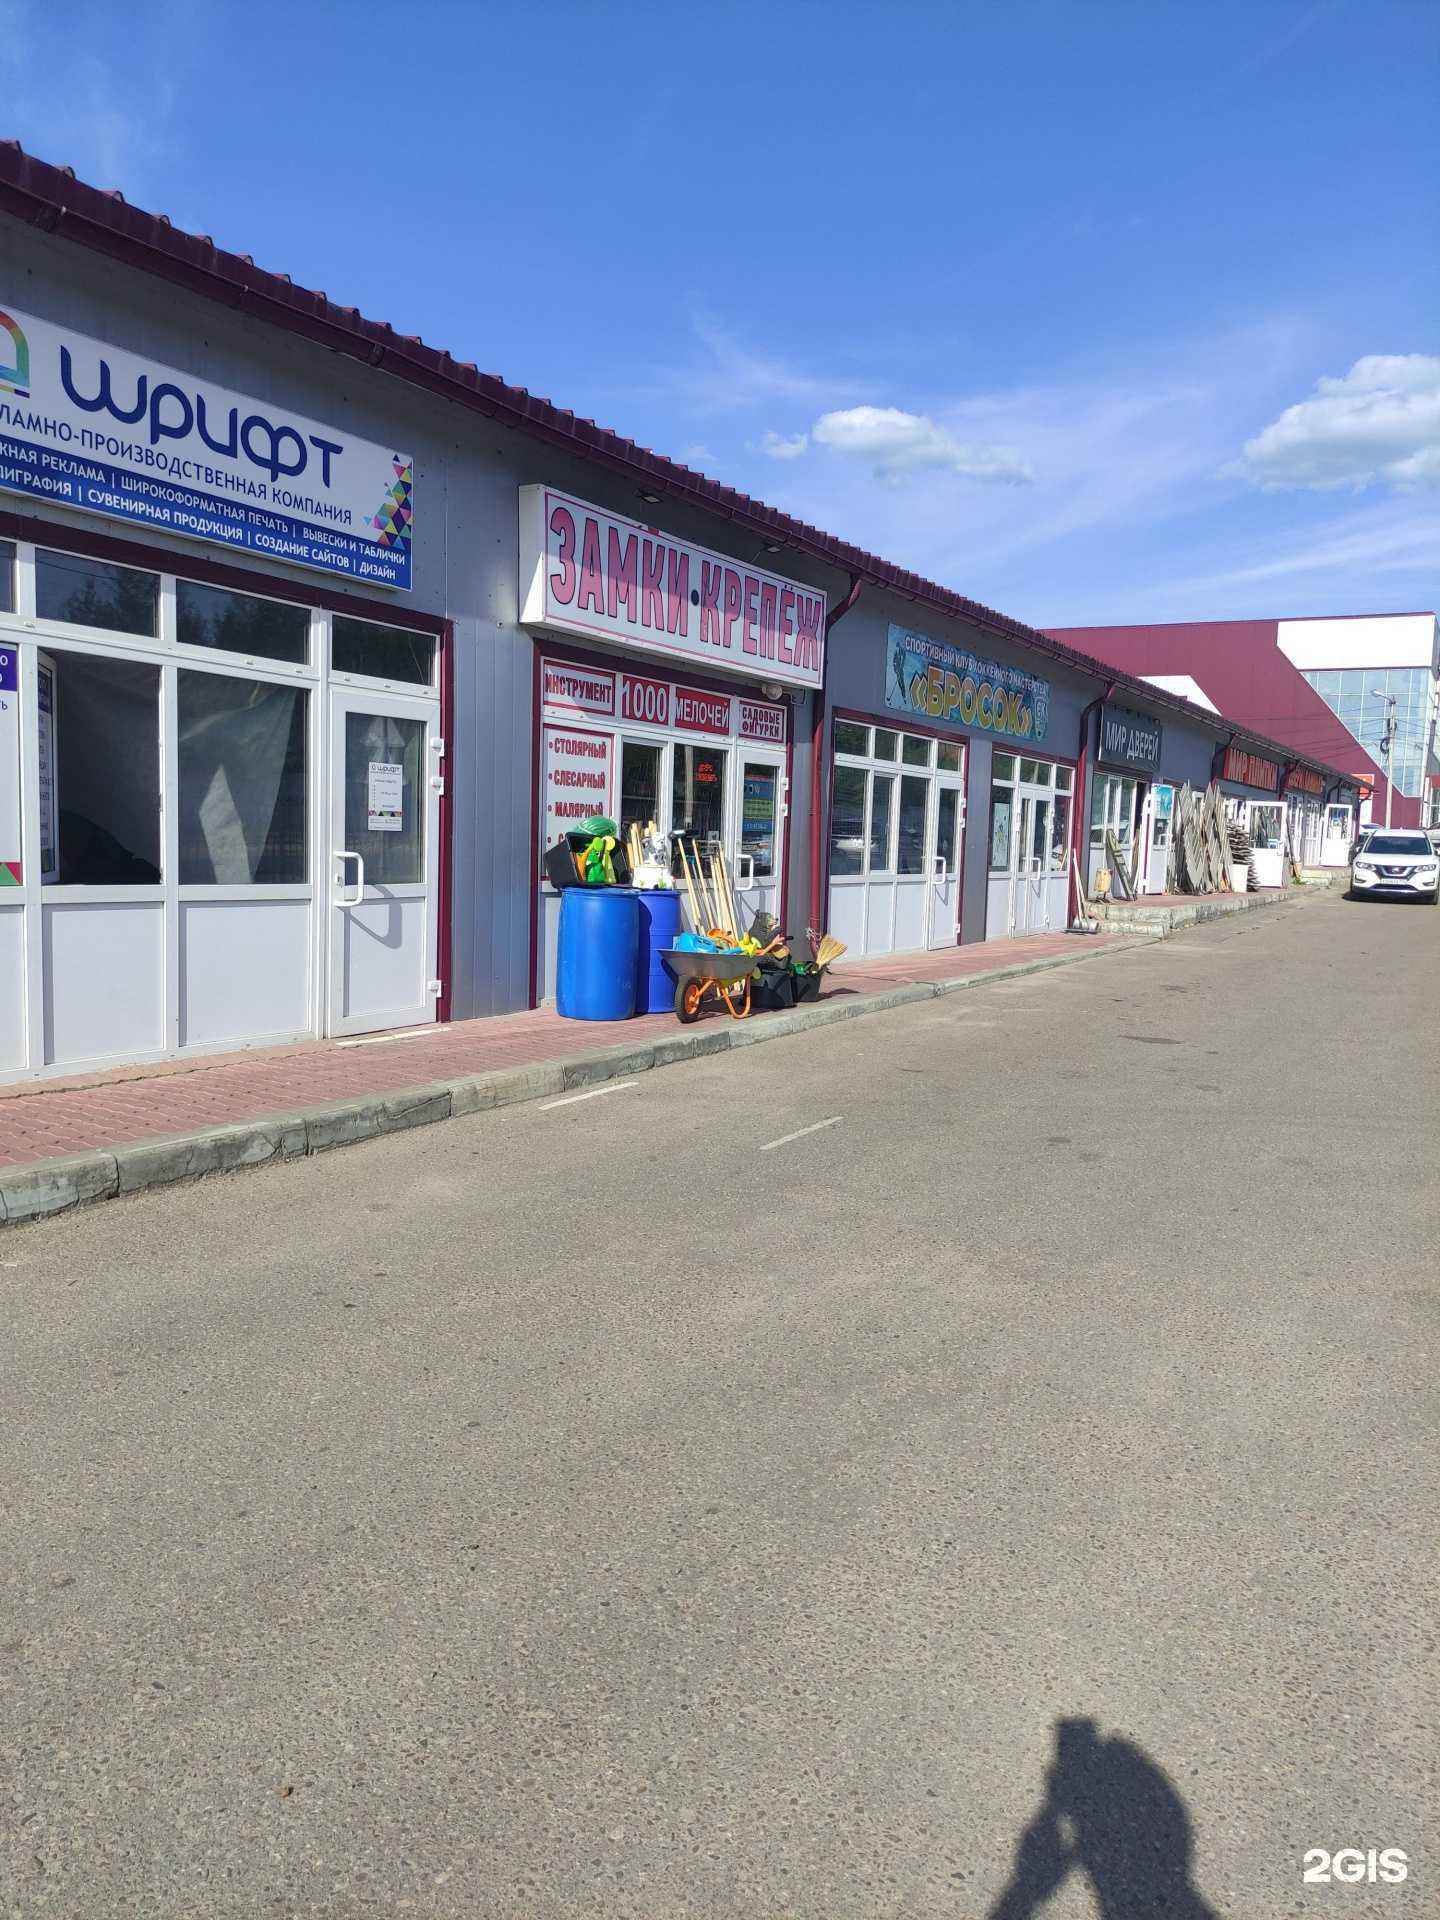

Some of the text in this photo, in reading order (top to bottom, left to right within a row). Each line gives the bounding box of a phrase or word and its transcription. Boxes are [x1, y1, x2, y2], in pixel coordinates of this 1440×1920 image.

[42, 453, 106, 484] РЕКЛАМА
[121, 476, 246, 522] ШИРОКОФОРМАТНАЯ
[248, 511, 289, 534] ПЕЧАТЬ
[303, 527, 347, 550] ВЫВЕСКИ
[350, 539, 357, 552] И
[358, 543, 406, 566] ТАБЛИЧКИ
[272, 487, 352, 526] КОМПАНИЯ
[88, 489, 171, 522] СУВЕНИРНАЯ
[173, 510, 243, 541] ПРОДУКЦИЯ
[255, 533, 309, 558] СОЗДАНИЕ
[311, 548, 350, 568] САЙТОВ
[359, 561, 396, 580] ДИЗАЙН
[549, 507, 690, 638] ЗАМКИ
[905, 635, 956, 665] СПОРТИВНЫЙ
[544, 672, 612, 704] ИНСТРУМЕНТ
[622, 680, 729, 728] 1000 МЕЛОЧЕЙ
[742, 706, 780, 725] САДОВЫЕ
[742, 721, 780, 737] ФИГУРКИ
[554, 737, 607, 761] СТОЛЯРНЫЙ
[1105, 721, 1159, 762] МИР ДВЕРЕЙ
[554, 770, 606, 790] СЛЕСАРНЫЙ
[555, 801, 603, 819] МАЛЯРНЫЙ
